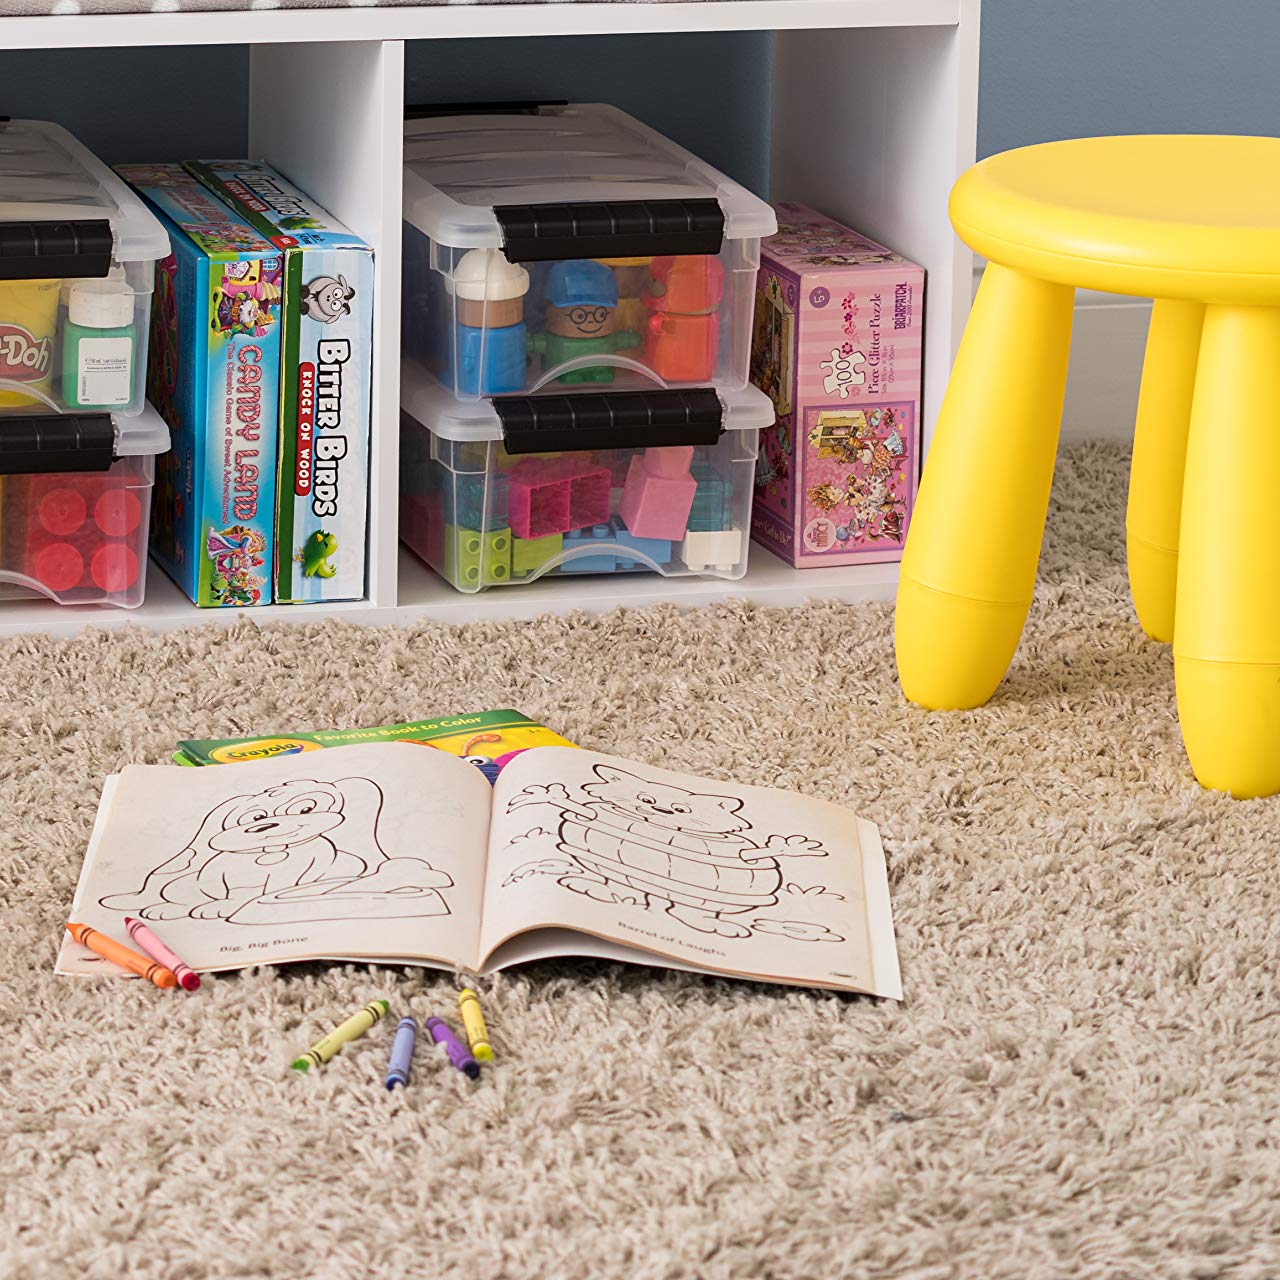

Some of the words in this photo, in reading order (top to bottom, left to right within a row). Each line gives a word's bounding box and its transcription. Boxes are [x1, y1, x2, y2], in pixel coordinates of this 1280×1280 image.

[869, 293, 882, 328] Puzzle
[226, 342, 236, 360] The
[868, 330, 881, 367] Glitter
[225, 361, 236, 396] Classic
[316, 339, 351, 429] BITTER
[834, 360, 853, 388] 100
[868, 368, 880, 394] Piece
[236, 344, 263, 441] CANDY
[301, 371, 313, 415] KNOCK
[225, 397, 235, 425] Game
[225, 426, 234, 437] of
[300, 422, 312, 441] ON
[223, 438, 233, 467] Sweet
[298, 448, 310, 488] WOOD
[233, 449, 260, 521] LAND
[312, 435, 348, 517] BIRDS
[313, 731, 377, 742] Favorite
[380, 725, 419, 736] Book
[421, 722, 439, 731] to
[440, 715, 482, 727] Color
[226, 742, 298, 759] Crayola
[273, 937, 308, 945] Bone
[618, 921, 657, 938] Barrel
[679, 939, 726, 957] Laughs
